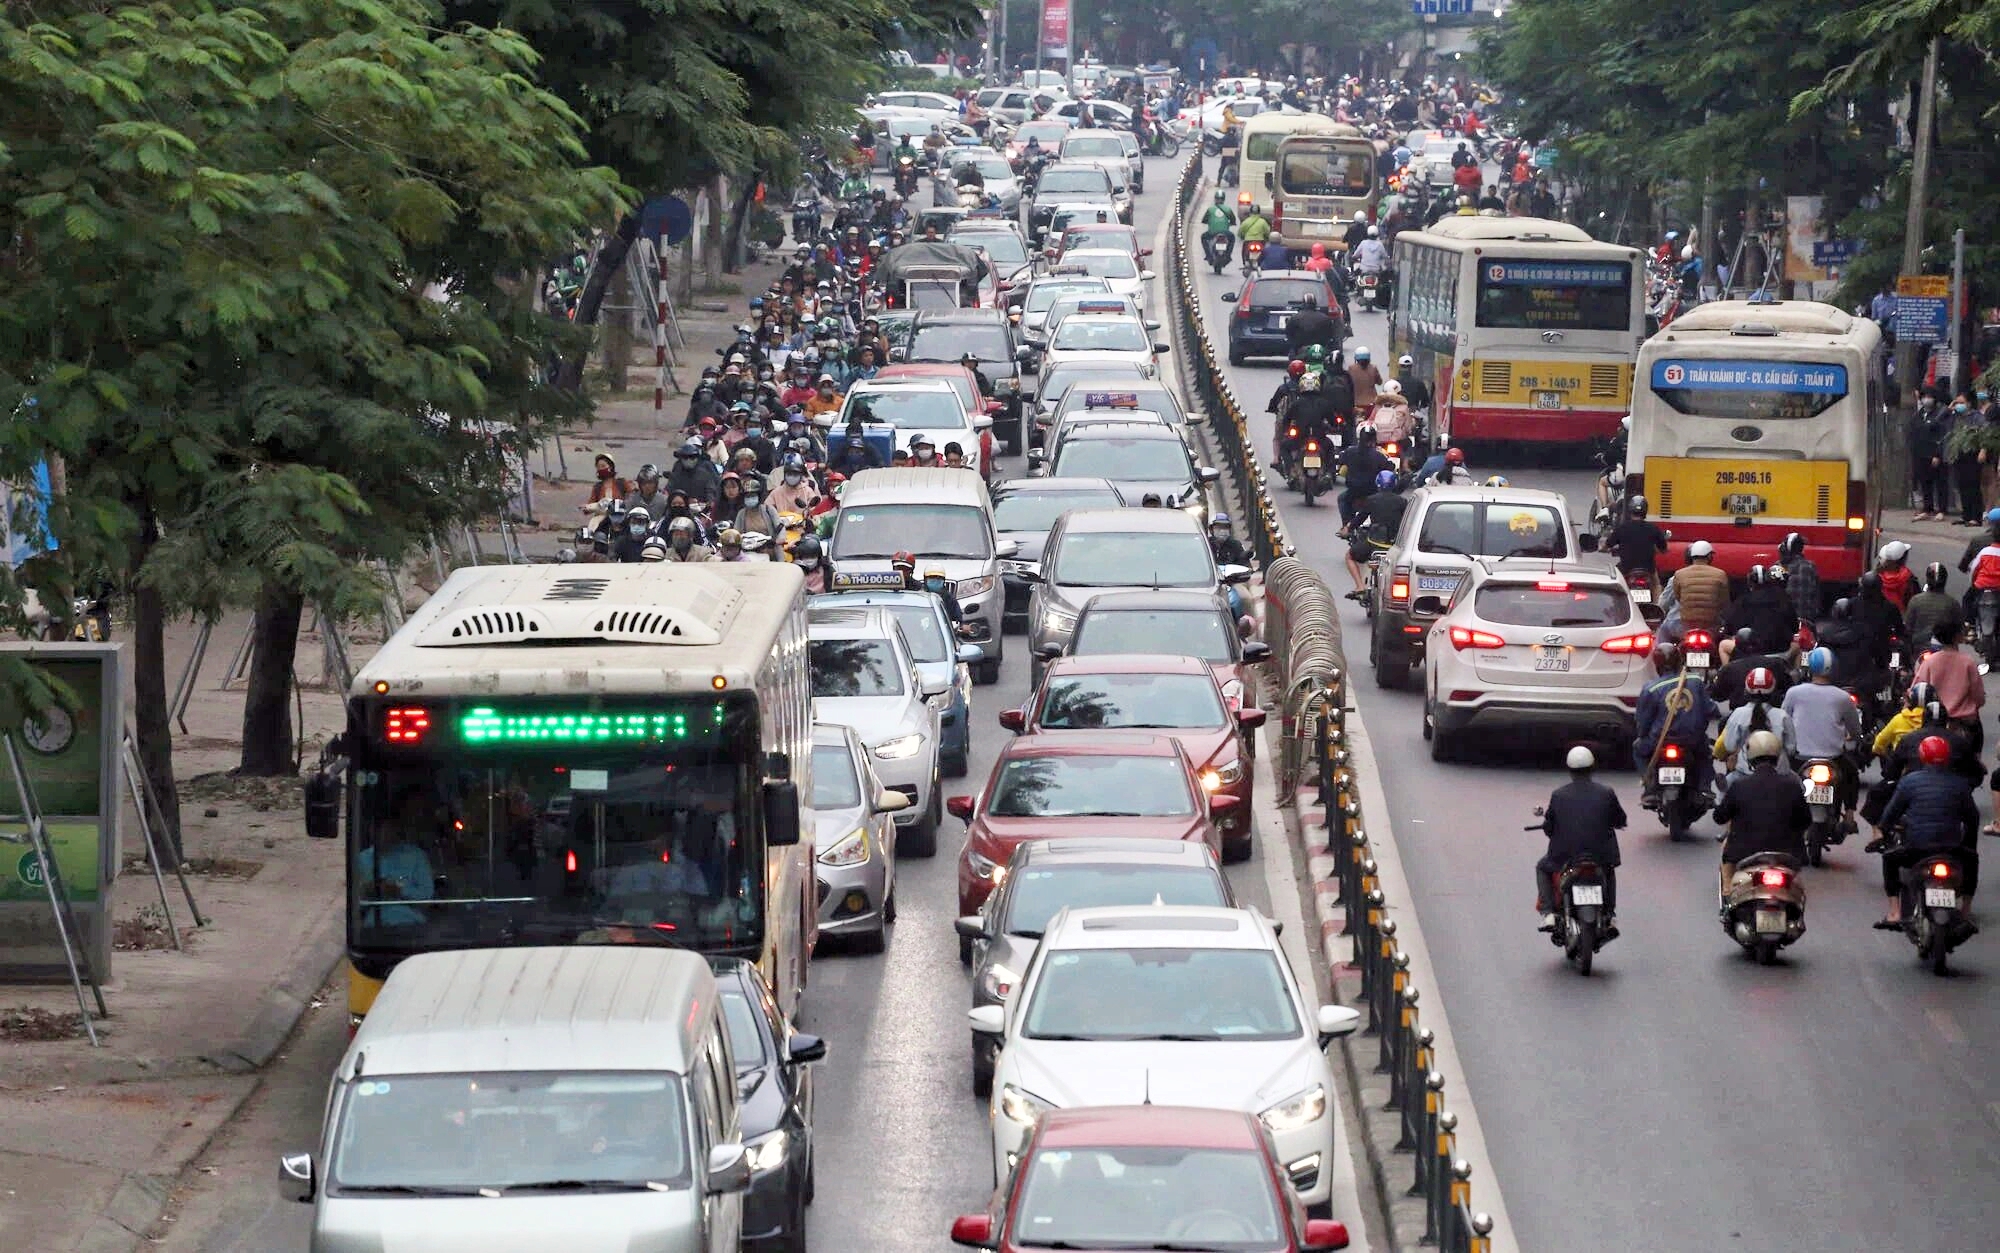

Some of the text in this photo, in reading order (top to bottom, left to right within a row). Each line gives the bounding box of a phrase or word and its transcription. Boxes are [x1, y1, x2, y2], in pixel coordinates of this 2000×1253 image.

[1491, 268, 1503, 278] 12
[1667, 369, 1682, 380] 51
[1716, 471, 1772, 485] 29B-096.16
[885, 574, 901, 584] SAO
